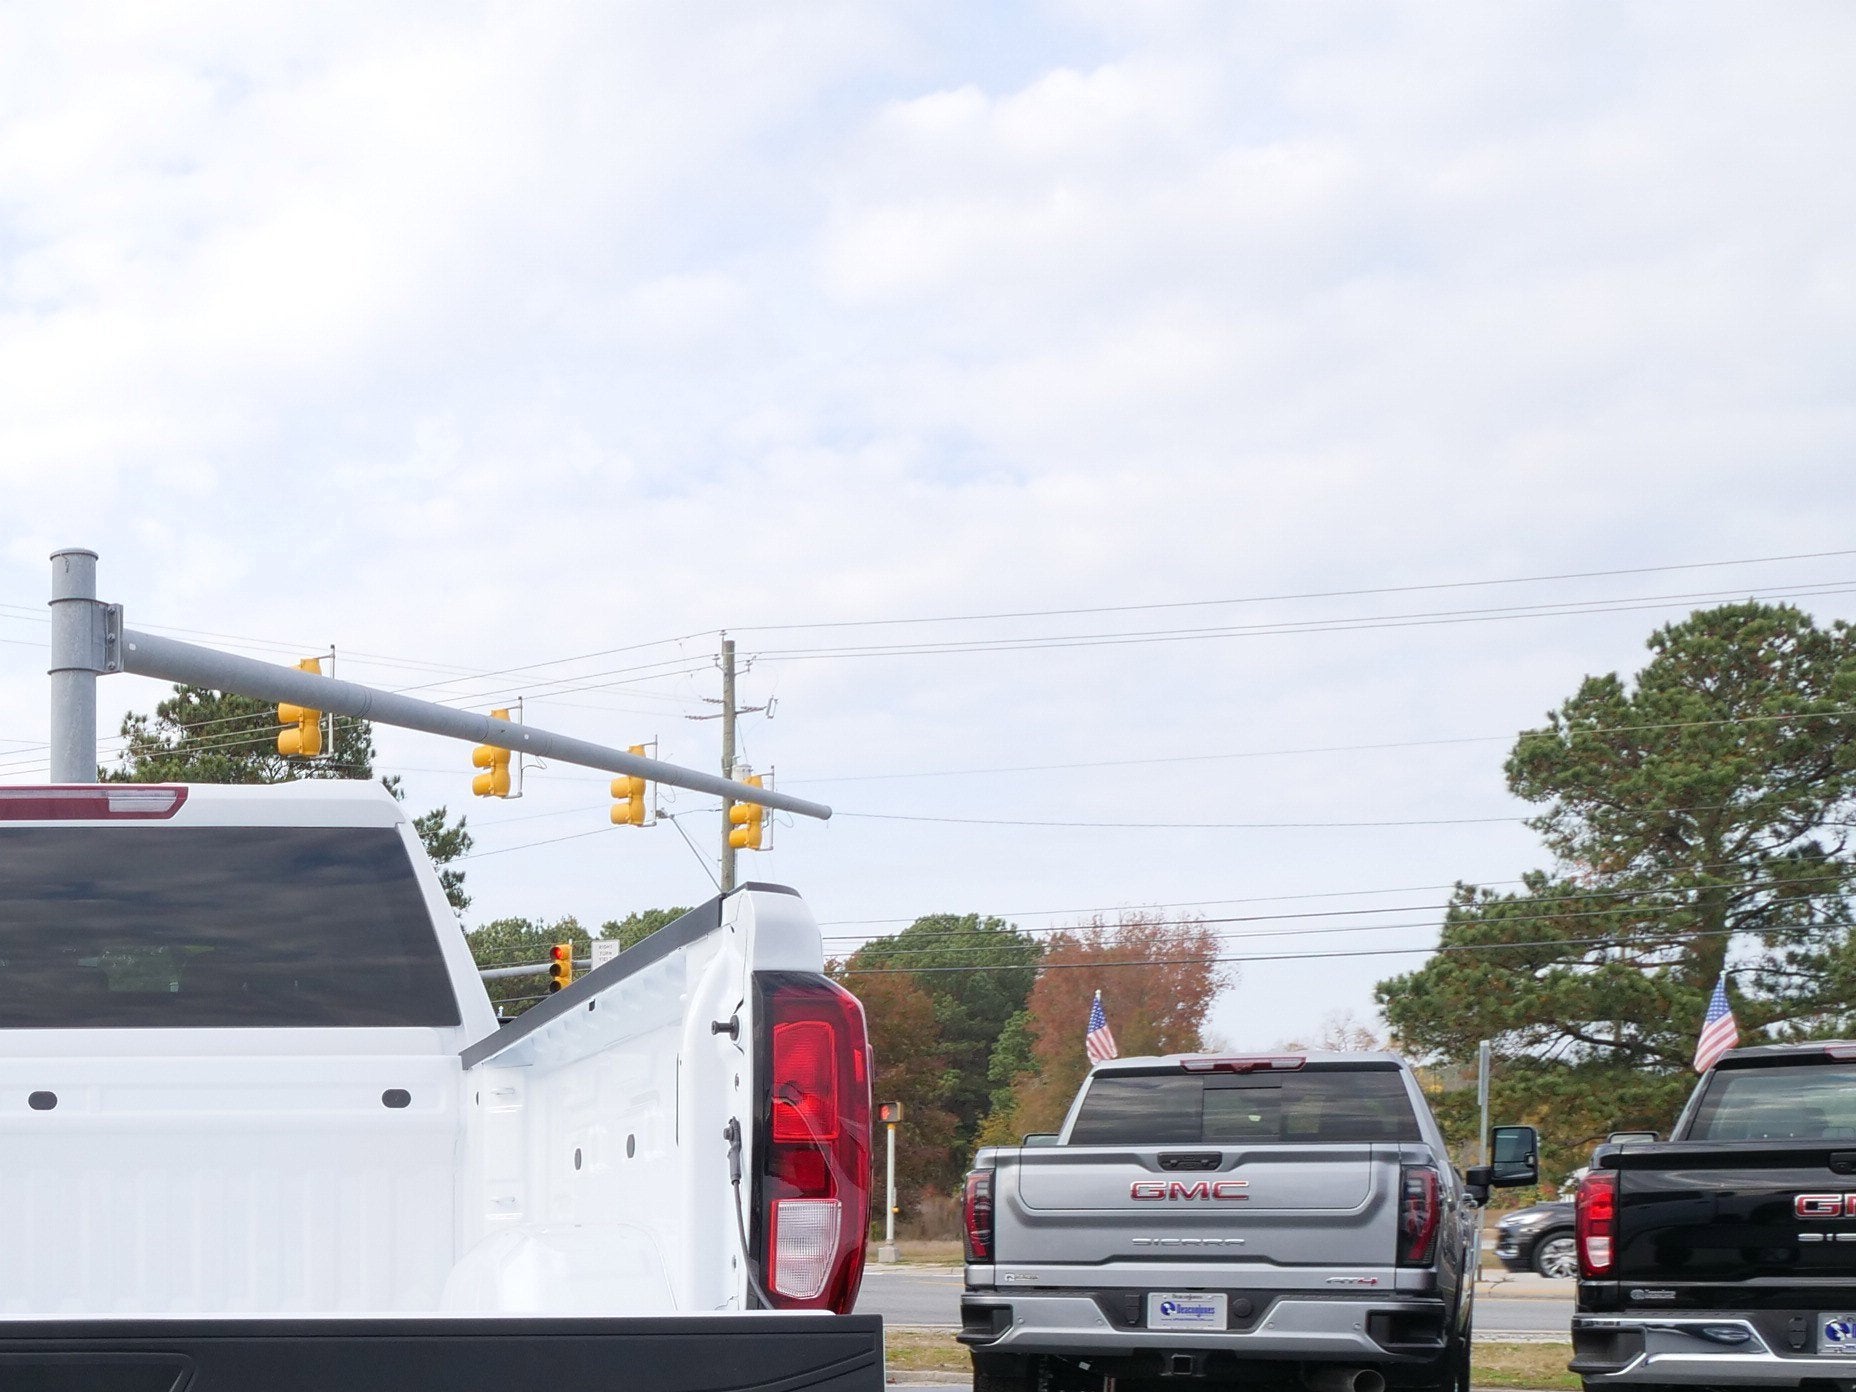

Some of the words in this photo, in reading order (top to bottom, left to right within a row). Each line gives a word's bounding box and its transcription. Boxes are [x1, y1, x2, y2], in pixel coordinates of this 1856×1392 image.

[1130, 1180, 1250, 1201] GMC
[1794, 1194, 1856, 1219] G
[1131, 1238, 1246, 1247] SIERRA
